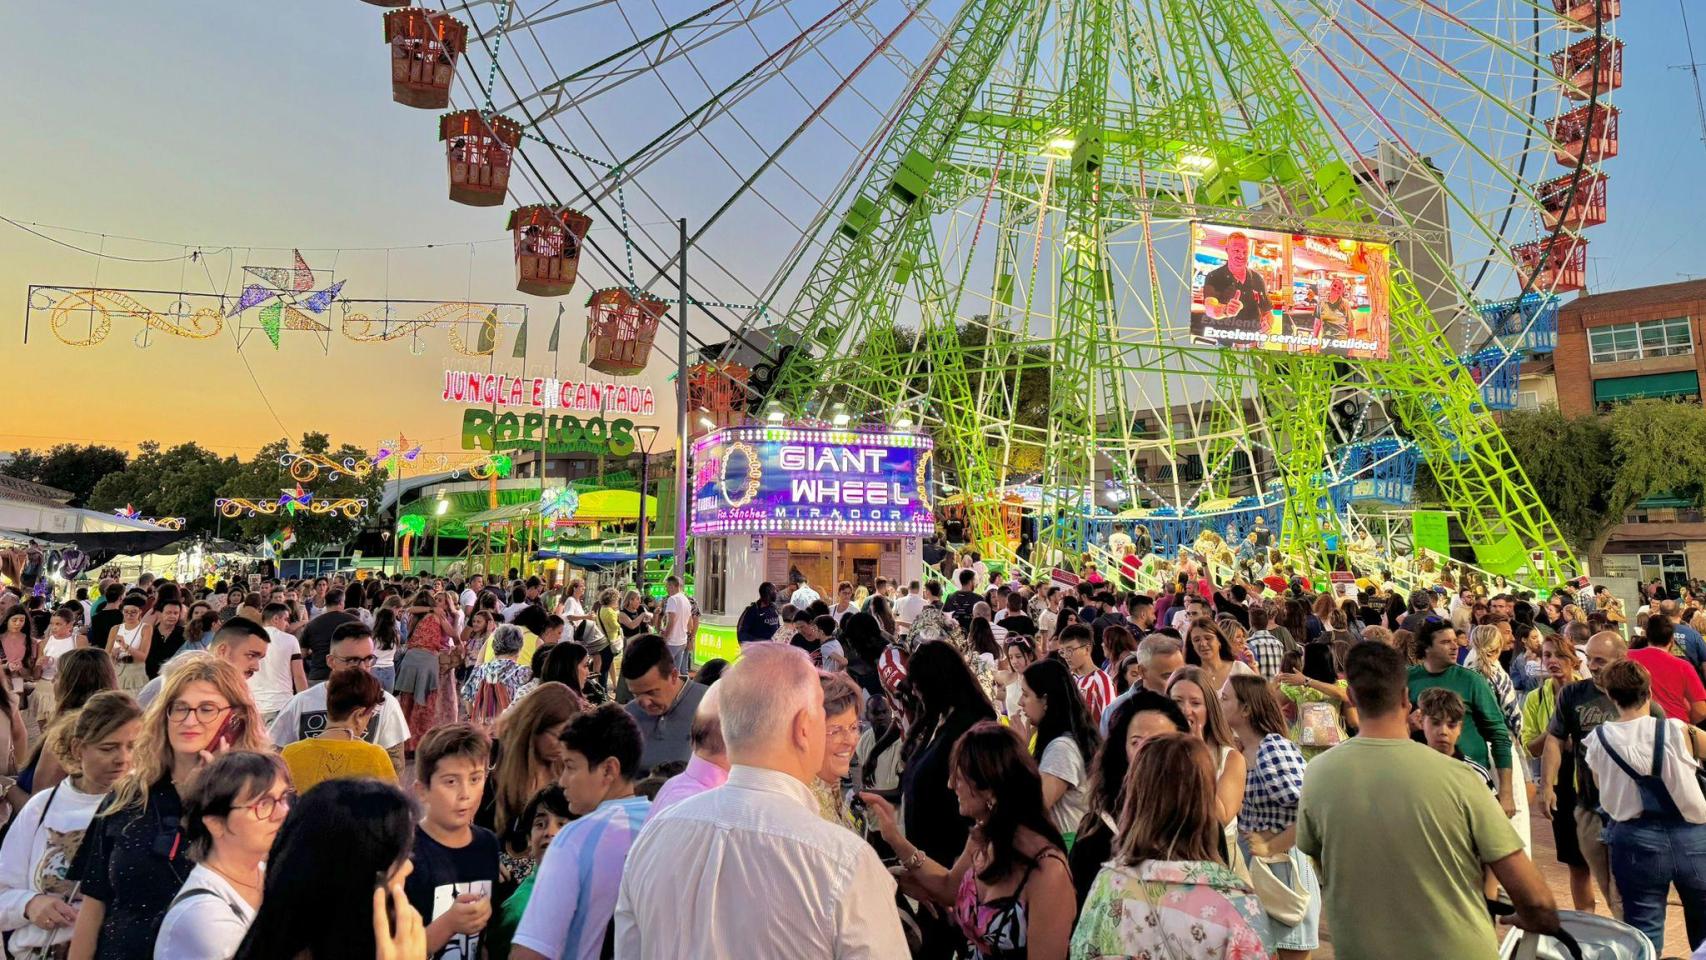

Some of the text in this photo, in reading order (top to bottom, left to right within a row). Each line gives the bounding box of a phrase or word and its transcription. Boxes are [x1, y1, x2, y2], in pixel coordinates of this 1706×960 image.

[1203, 326, 1378, 350] Excelente servicio y calidad
[442, 370, 655, 416] JUNGLA ENCANTADA
[462, 408, 635, 456] RAPIDOS
[779, 444, 889, 474] GIANT
[791, 478, 911, 505] WHEEL
[729, 507, 768, 520] Sánchez
[775, 508, 901, 520] MIRADOR
